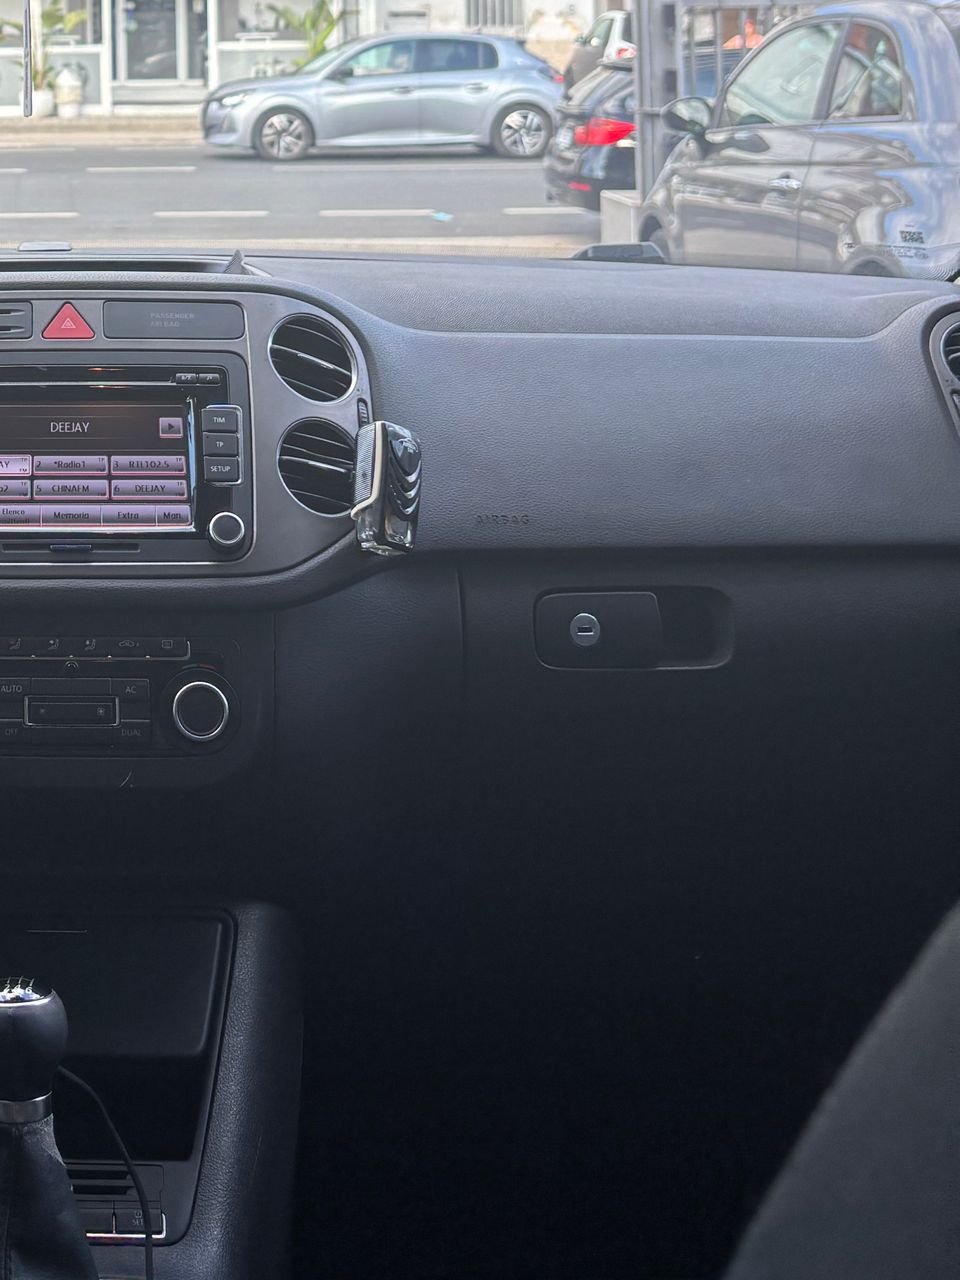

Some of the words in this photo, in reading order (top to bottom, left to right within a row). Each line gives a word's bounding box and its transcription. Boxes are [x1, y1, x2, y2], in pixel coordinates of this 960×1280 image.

[50, 422, 90, 433] DEEJAY
[36, 461, 41, 469] 2
[114, 461, 119, 469] 3
[0, 685, 23, 693] AUTO
[125, 685, 137, 693] AC
[5, 728, 18, 736] OFF
[121, 728, 142, 736] DUAL
